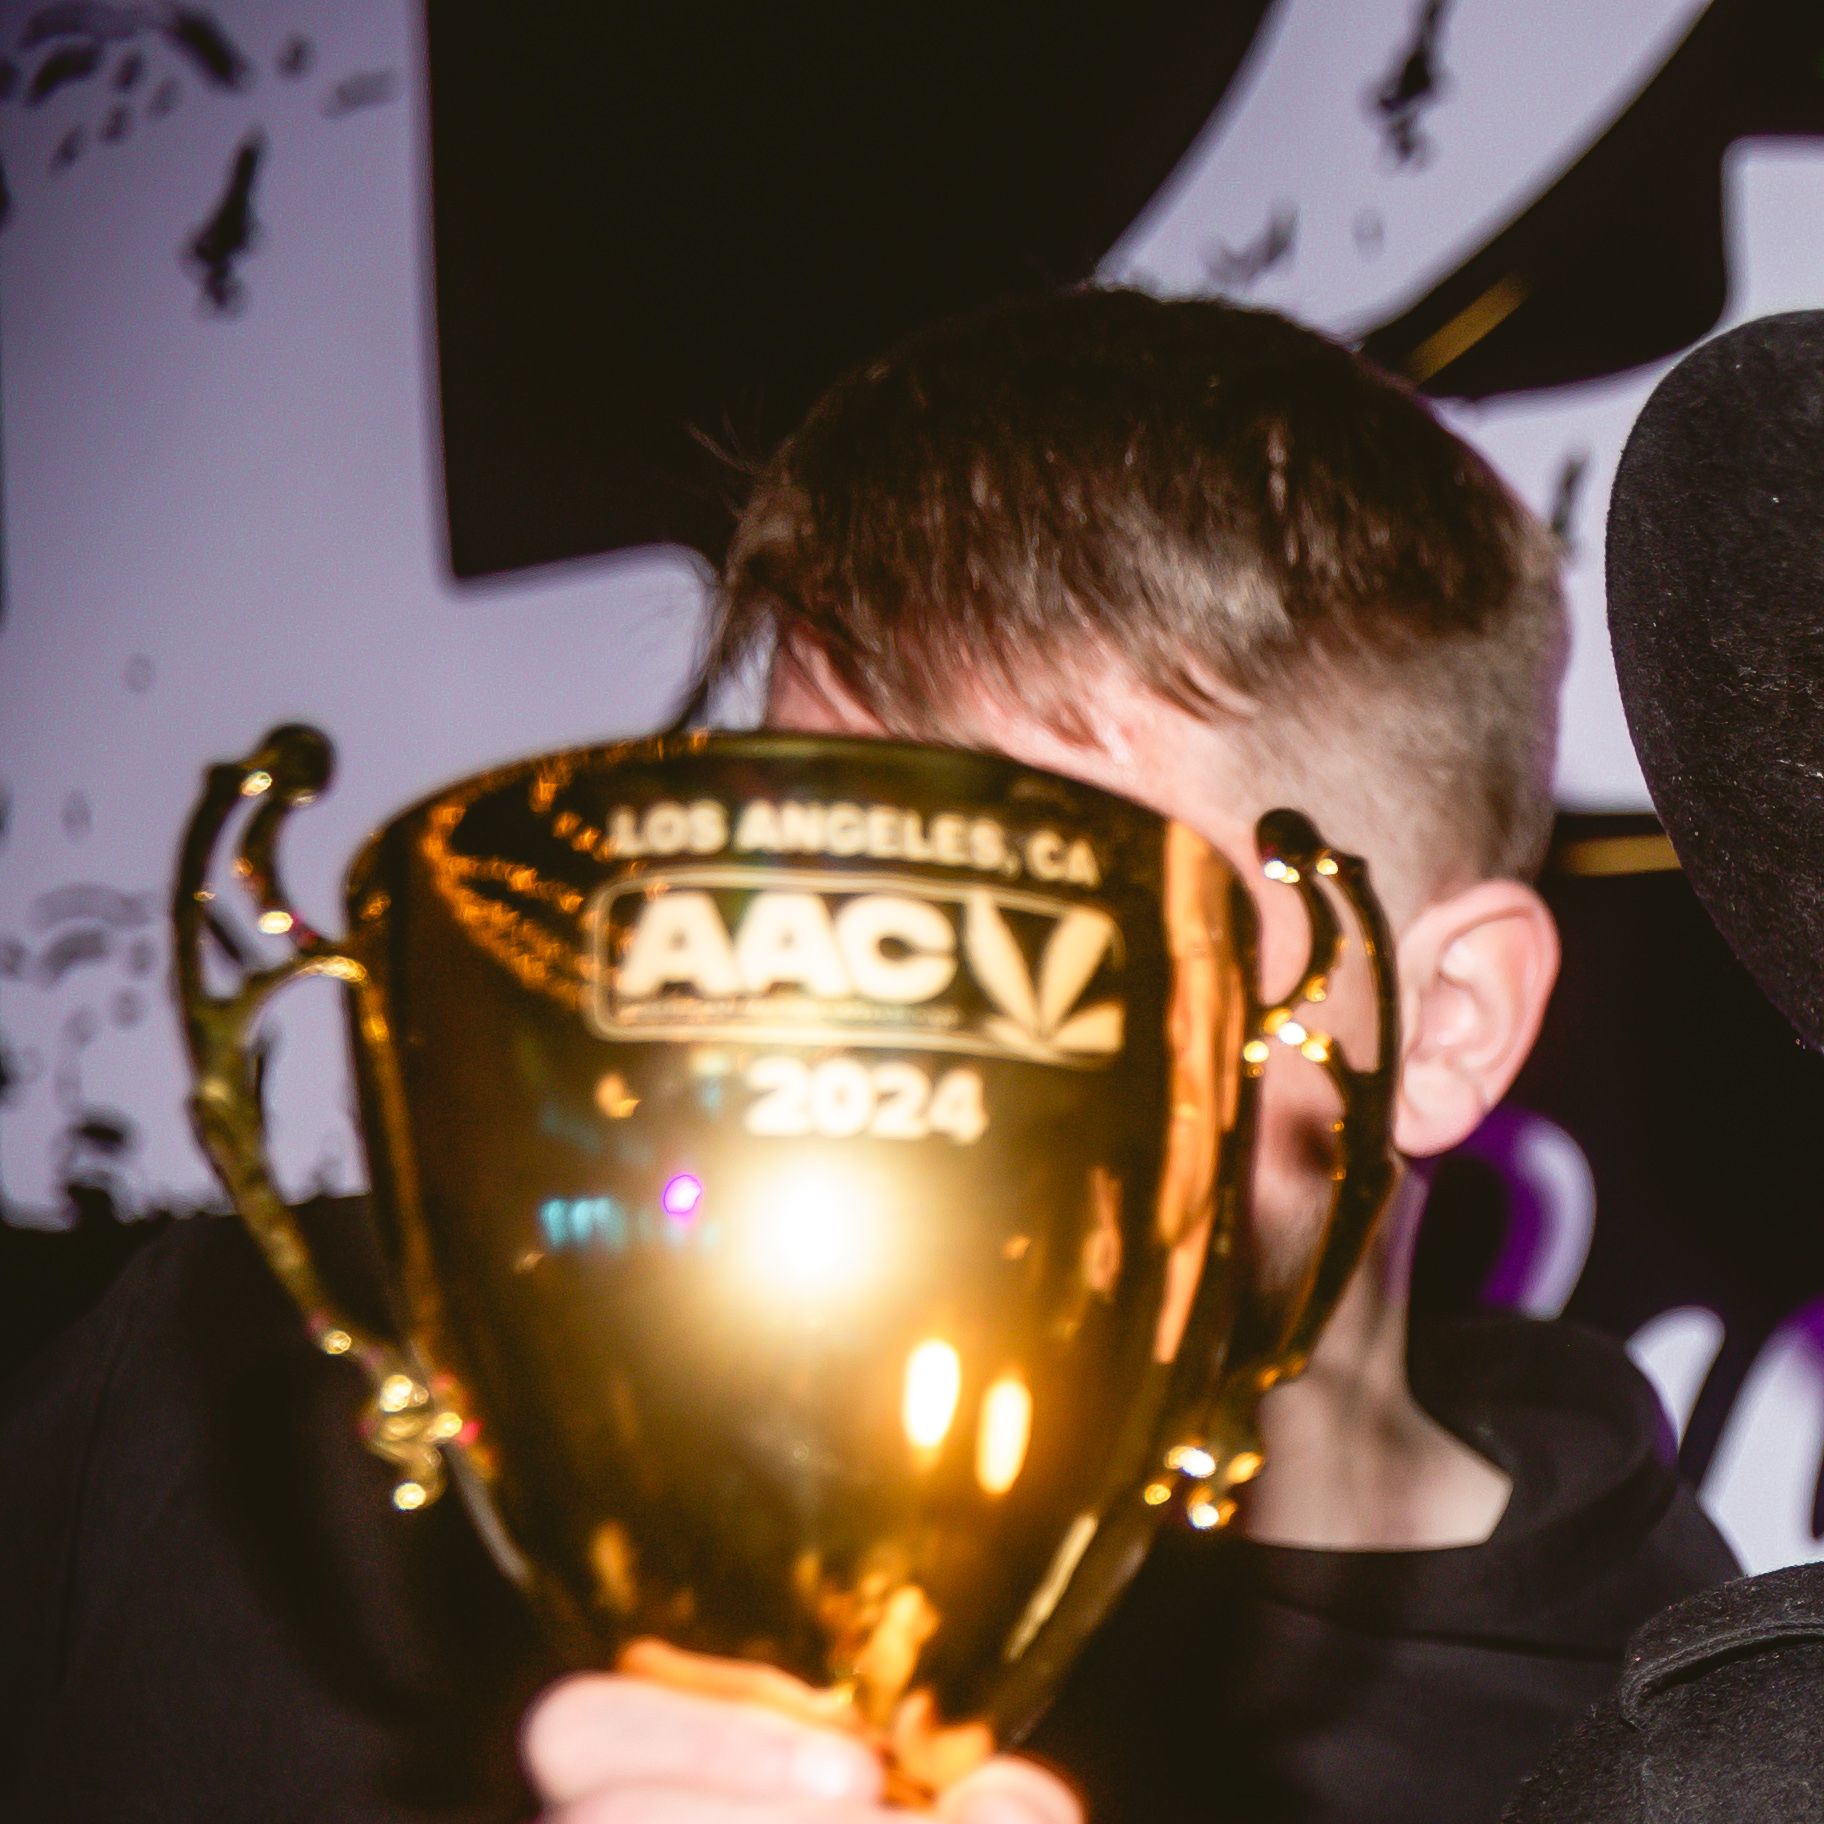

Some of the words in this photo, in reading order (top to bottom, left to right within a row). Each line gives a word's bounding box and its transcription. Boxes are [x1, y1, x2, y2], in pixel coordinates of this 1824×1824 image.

[607, 801, 729, 858] LOS
[735, 800, 1020, 879] ANGELES,
[1023, 831, 1102, 888] CA
[617, 891, 959, 1005] AAC
[745, 1056, 990, 1146] 2024
